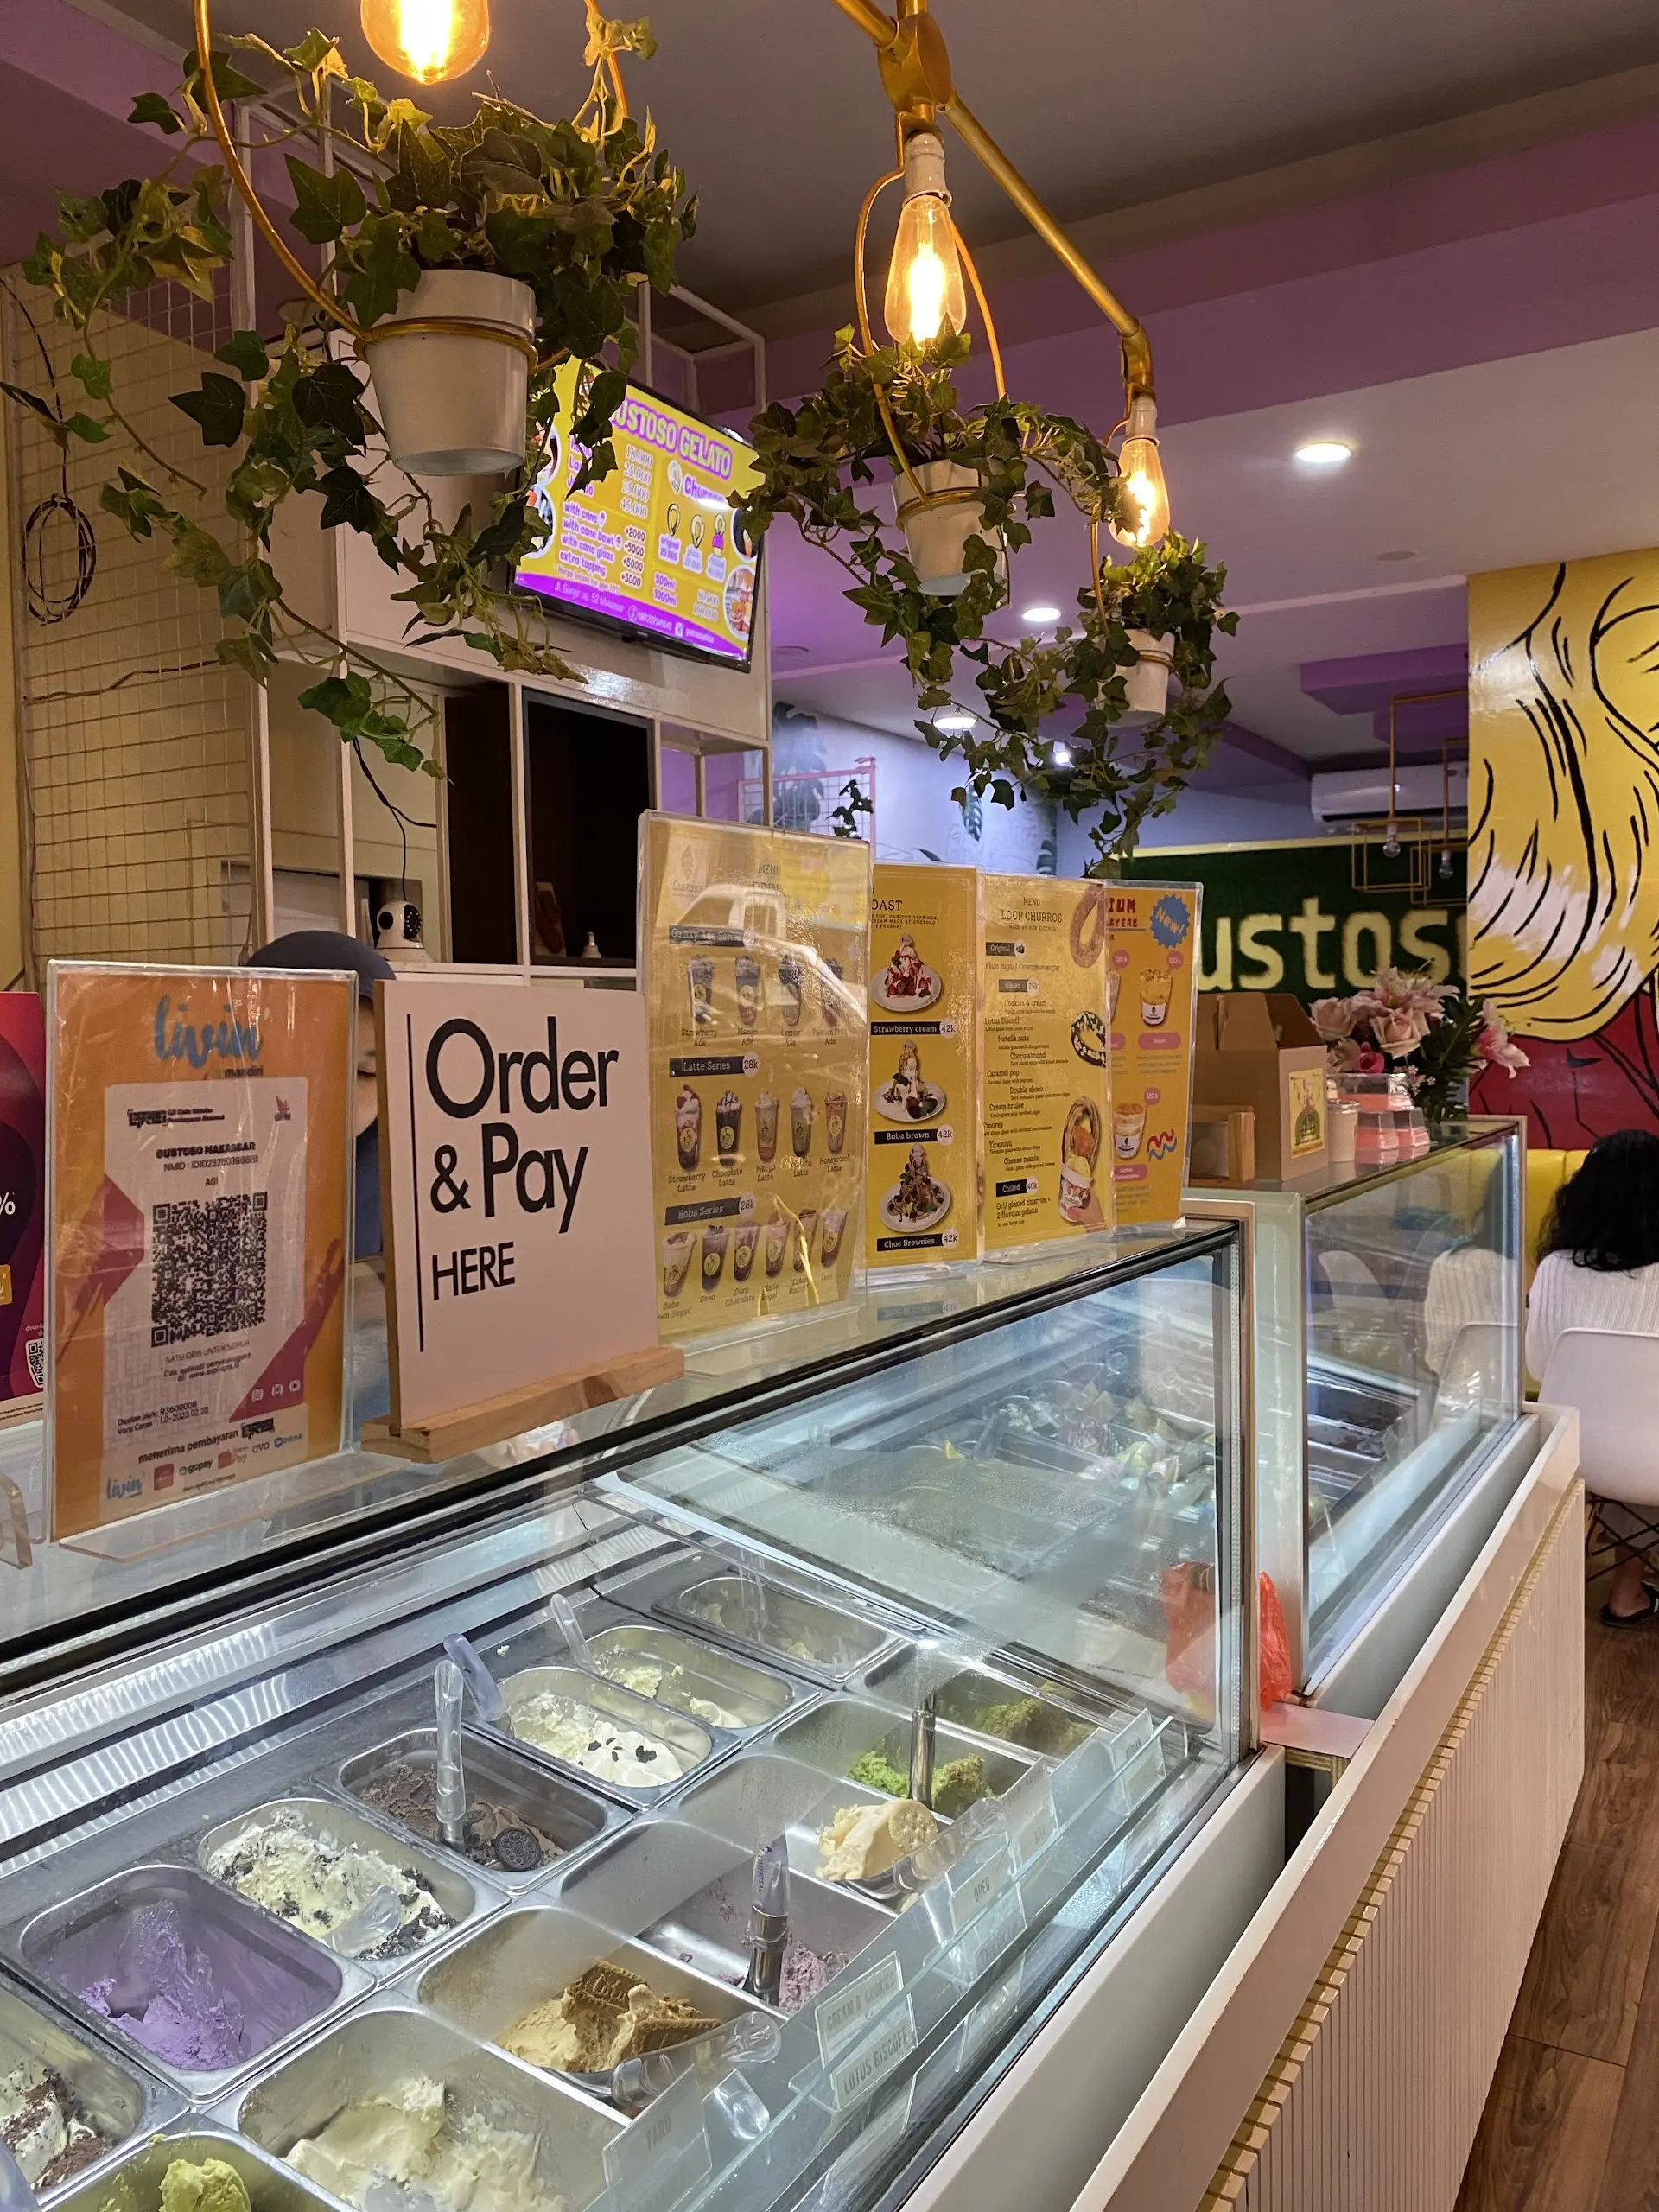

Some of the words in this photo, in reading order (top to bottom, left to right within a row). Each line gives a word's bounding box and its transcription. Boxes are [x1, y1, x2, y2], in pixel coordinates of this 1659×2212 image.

[613, 400, 677, 451] USTOSO
[679, 430, 731, 477] GELATO
[564, 502, 580, 516] with
[582, 510, 598, 524] cone
[563, 518, 579, 532] with
[580, 526, 596, 539] cone
[597, 530, 614, 545] bowl
[626, 527, 645, 542] +2000
[562, 534, 578, 547] with
[579, 542, 595, 554] cone
[596, 547, 614, 563] glaze
[624, 543, 645, 557] +5000
[560, 551, 580, 565] extra
[581, 558, 606, 577] topping
[623, 558, 643, 572] +5000
[621, 574, 641, 588] +5000
[656, 574, 676, 590] 500ml
[654, 588, 677, 606] 1000ml
[758, 863, 782, 875] MENU
[672, 880, 702, 893] Gustoso
[1023, 897, 1041, 906] MENU
[1001, 909, 1023, 920] LOOP
[1025, 911, 1063, 924] CHURROS
[1109, 918, 1138, 928] AYERS
[1155, 906, 1185, 937] New!
[671, 927, 698, 943] Galaxy
[1198, 895, 1469, 991] ustos
[154, 995, 264, 1070] livin
[681, 1027, 718, 1038] Strawberry
[873, 1025, 914, 1034] Strawberry
[941, 1024, 956, 1033] 42k
[1009, 1052, 1027, 1060] Choco
[425, 1015, 620, 1119] Order
[683, 1060, 706, 1072] Latte
[707, 1060, 731, 1071] Series
[743, 1058, 759, 1070] 28k
[987, 1069, 1008, 1077] Caramel
[1009, 1070, 1020, 1078] pop
[988, 1103, 1007, 1111] Cream
[886, 1132, 905, 1141] Boba
[906, 1131, 930, 1140] brown
[204, 1141, 256, 1155] MAKASSAR
[1003, 1156, 1022, 1165] Cheese
[429, 1144, 471, 1214] &
[480, 1122, 589, 1234] Pay
[668, 1172, 707, 1185] Strawberry
[711, 1166, 743, 1179] Chocolate
[757, 1173, 774, 1183] Latte
[793, 1169, 810, 1178] Latte
[677, 1183, 696, 1193] Latte
[718, 1178, 736, 1188] Latte
[1001, 1183, 1020, 1192] Chilled
[1027, 1181, 1038, 1191] 40k
[677, 1207, 698, 1220] Boba
[699, 1205, 724, 1217] Series
[740, 1199, 755, 1211] 28k
[1007, 1198, 1026, 1209] glazed
[1026, 1197, 1046, 1206] churros
[996, 1211, 1001, 1220] 2
[1001, 1209, 1020, 1219] flavour
[1020, 1207, 1039, 1217] gelato
[884, 1240, 902, 1249] Choc
[903, 1236, 935, 1248] Brownies
[943, 1234, 958, 1243] 42k
[431, 1240, 516, 1300] HERE
[699, 1294, 715, 1303] Oreo
[724, 1294, 756, 1307] Chocolate
[165, 1353, 185, 1363] SATU
[138, 1445, 186, 1464] menerima
[186, 1429, 238, 1454] pembayaran
[188, 1459, 213, 1475] gopay
[974, 1876, 990, 1903] OREO
[827, 1999, 855, 2031] CREAM
[855, 1994, 863, 2012] &
[842, 2057, 873, 2096] LOTUS
[874, 2026, 908, 2070] BISCOFF
[645, 2111, 673, 2152] TARO
